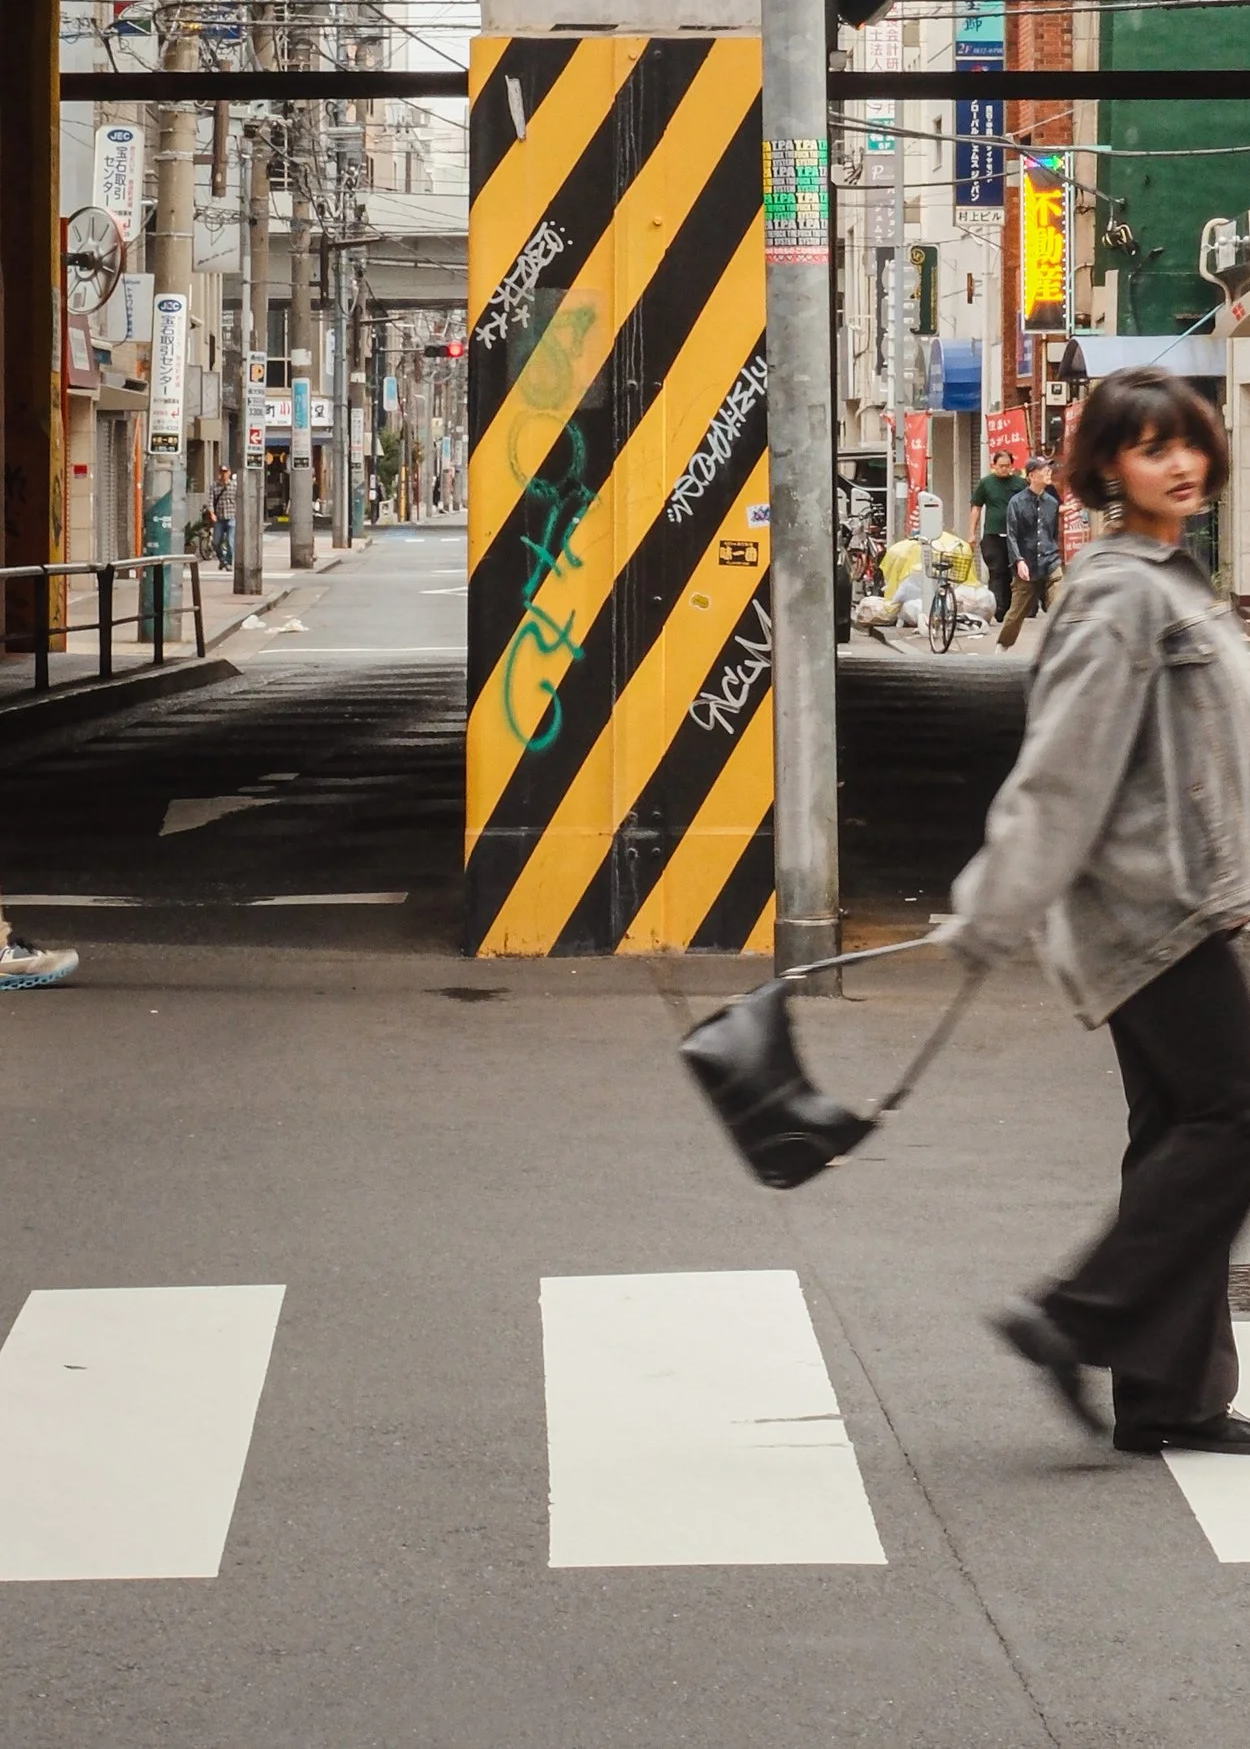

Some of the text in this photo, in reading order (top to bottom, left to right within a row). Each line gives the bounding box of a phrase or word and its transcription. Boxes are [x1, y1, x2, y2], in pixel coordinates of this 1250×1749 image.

[110, 131, 131, 141] JEC
[103, 154, 115, 207] センター
[114, 146, 128, 200] 宝石取引
[958, 210, 1002, 223] 村上ビル
[1036, 190, 1064, 301] 不動産
[159, 315, 176, 395] 宝石取引センター
[988, 418, 1011, 432] 住まい
[989, 432, 1026, 448] さがしは、
